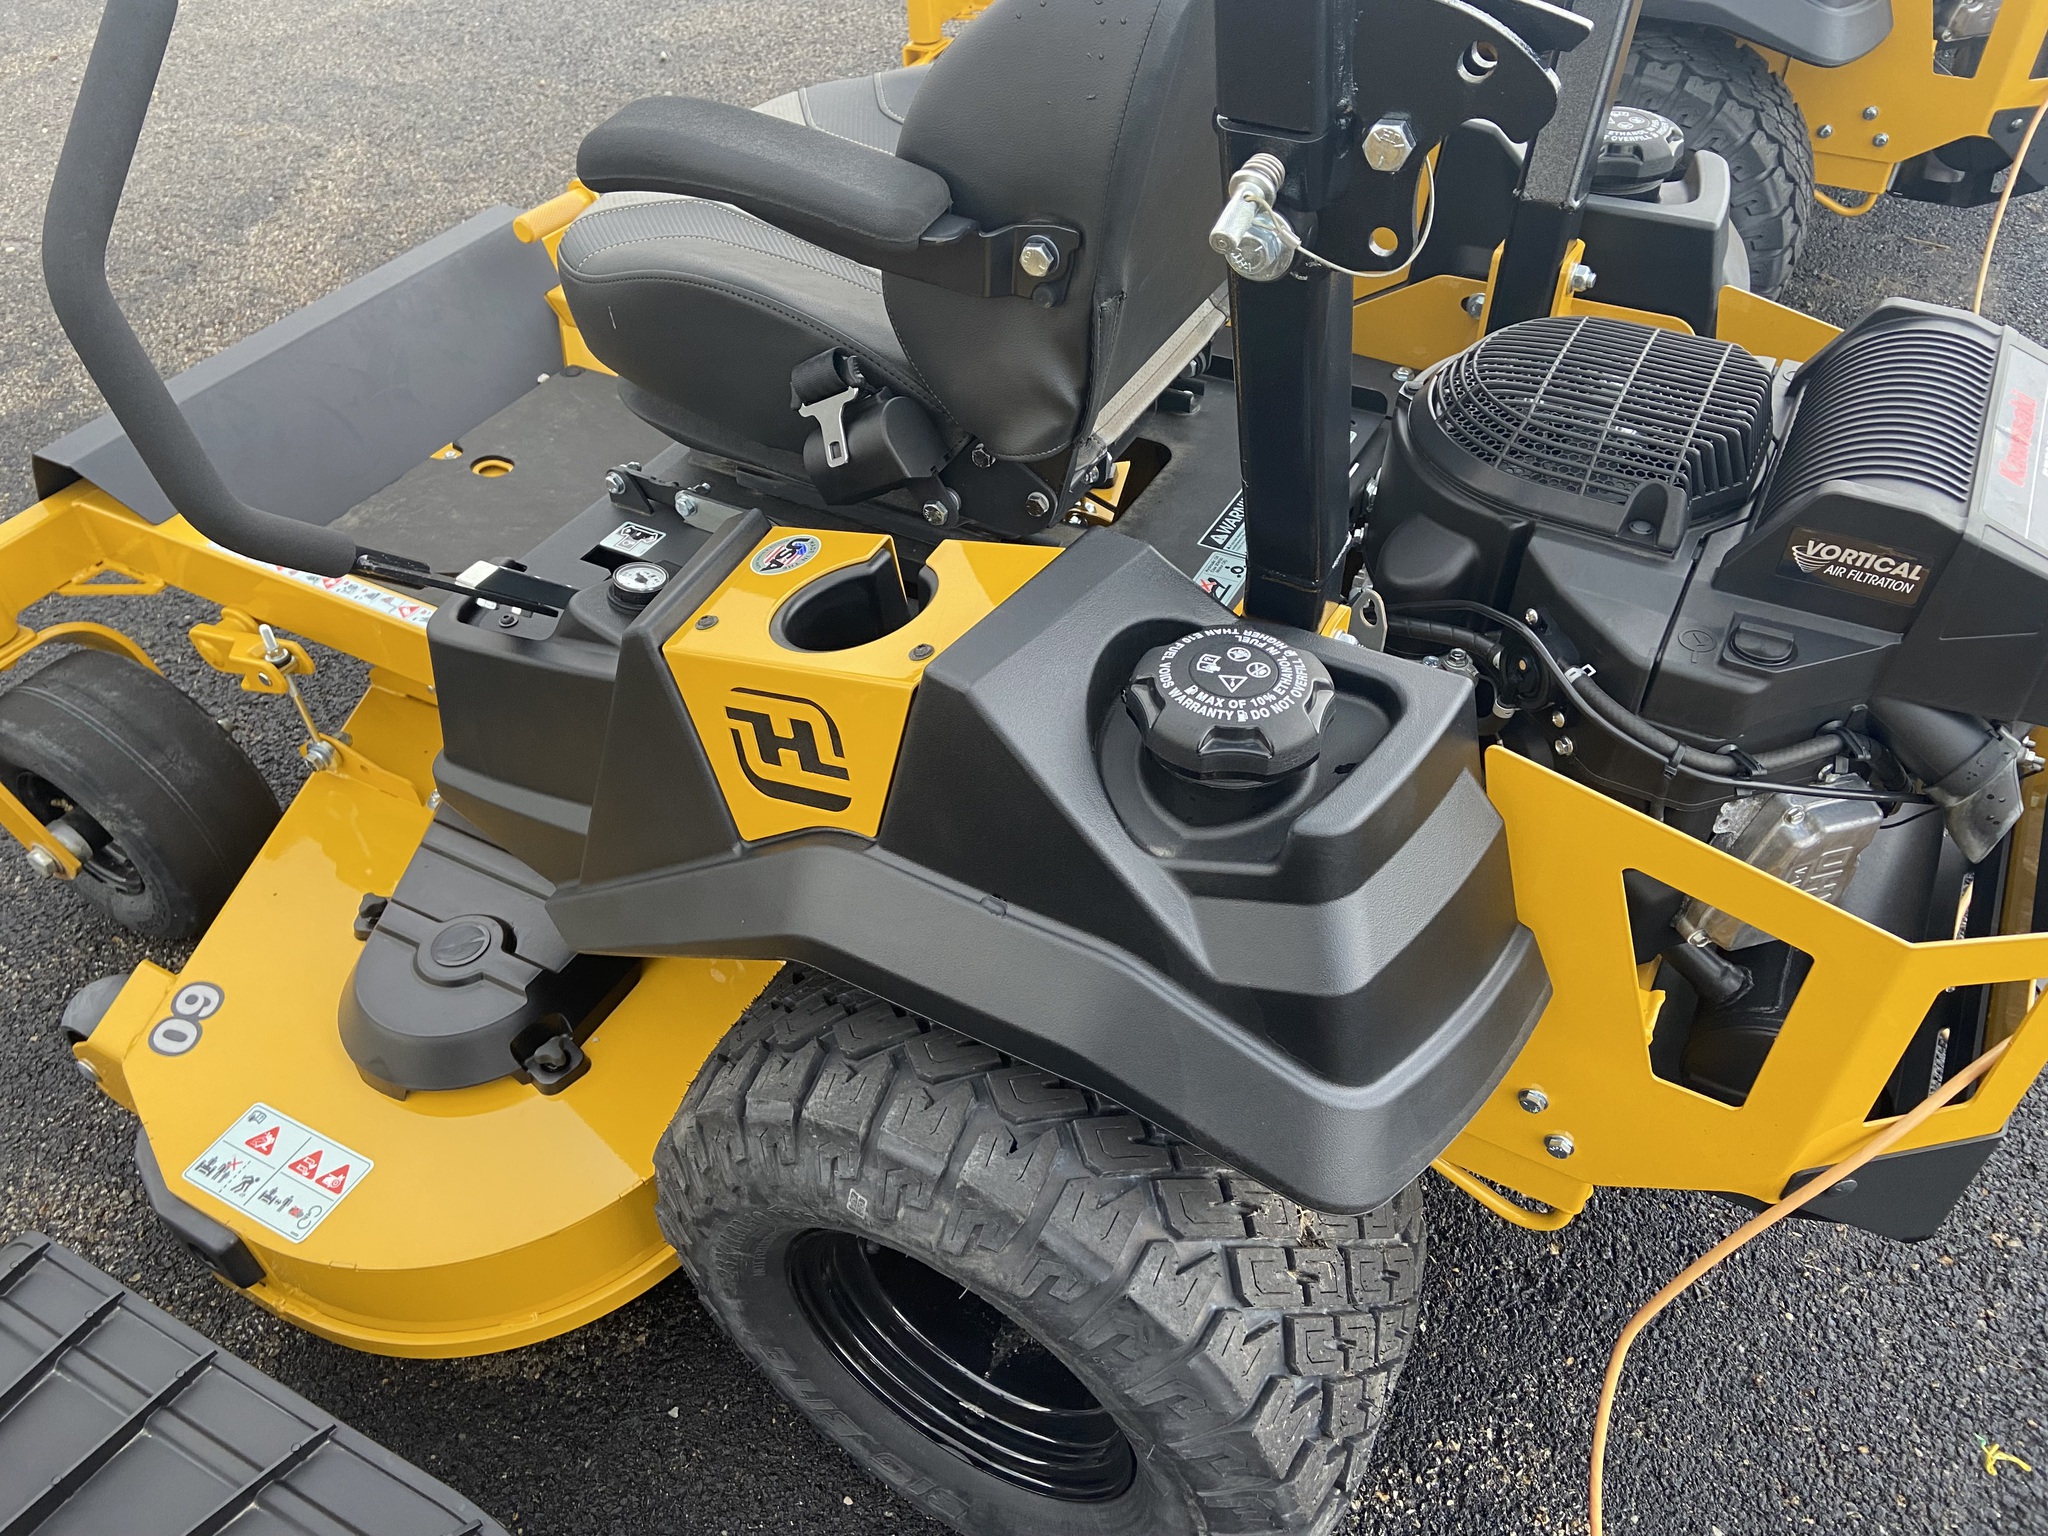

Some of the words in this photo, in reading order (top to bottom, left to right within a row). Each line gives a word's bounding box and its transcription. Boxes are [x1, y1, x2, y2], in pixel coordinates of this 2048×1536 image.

[1611, 134, 1653, 142] OVERFILL
[1998, 389, 2038, 488] Kawasaki
[1215, 497, 1245, 534] WARN
[759, 537, 811, 572] USA
[1806, 540, 1923, 580] VORTICAL
[1824, 564, 1847, 578] AIR
[1846, 569, 1915, 594] FILTRATION
[1181, 632, 1205, 644] E10
[1204, 628, 1240, 636] THAN
[1235, 635, 1268, 649] FUEL
[1243, 629, 1289, 650] HIGHER
[1161, 642, 1186, 661] FUEL
[1265, 646, 1281, 656] IN
[1158, 662, 1175, 689] VOIDS
[1250, 707, 1271, 720] DO
[1269, 695, 1295, 715] NOT
[1290, 658, 1308, 698] OVERFILL
[1272, 656, 1294, 695] ETHANOL
[1168, 686, 1234, 721] WARRANTY
[1195, 691, 1225, 708] MAX
[1228, 699, 1247, 709] OF
[1250, 692, 1277, 707] 10%
[149, 982, 225, 1056] 60
[760, 1343, 868, 1438] BITE
[871, 1452, 971, 1520] BIG
